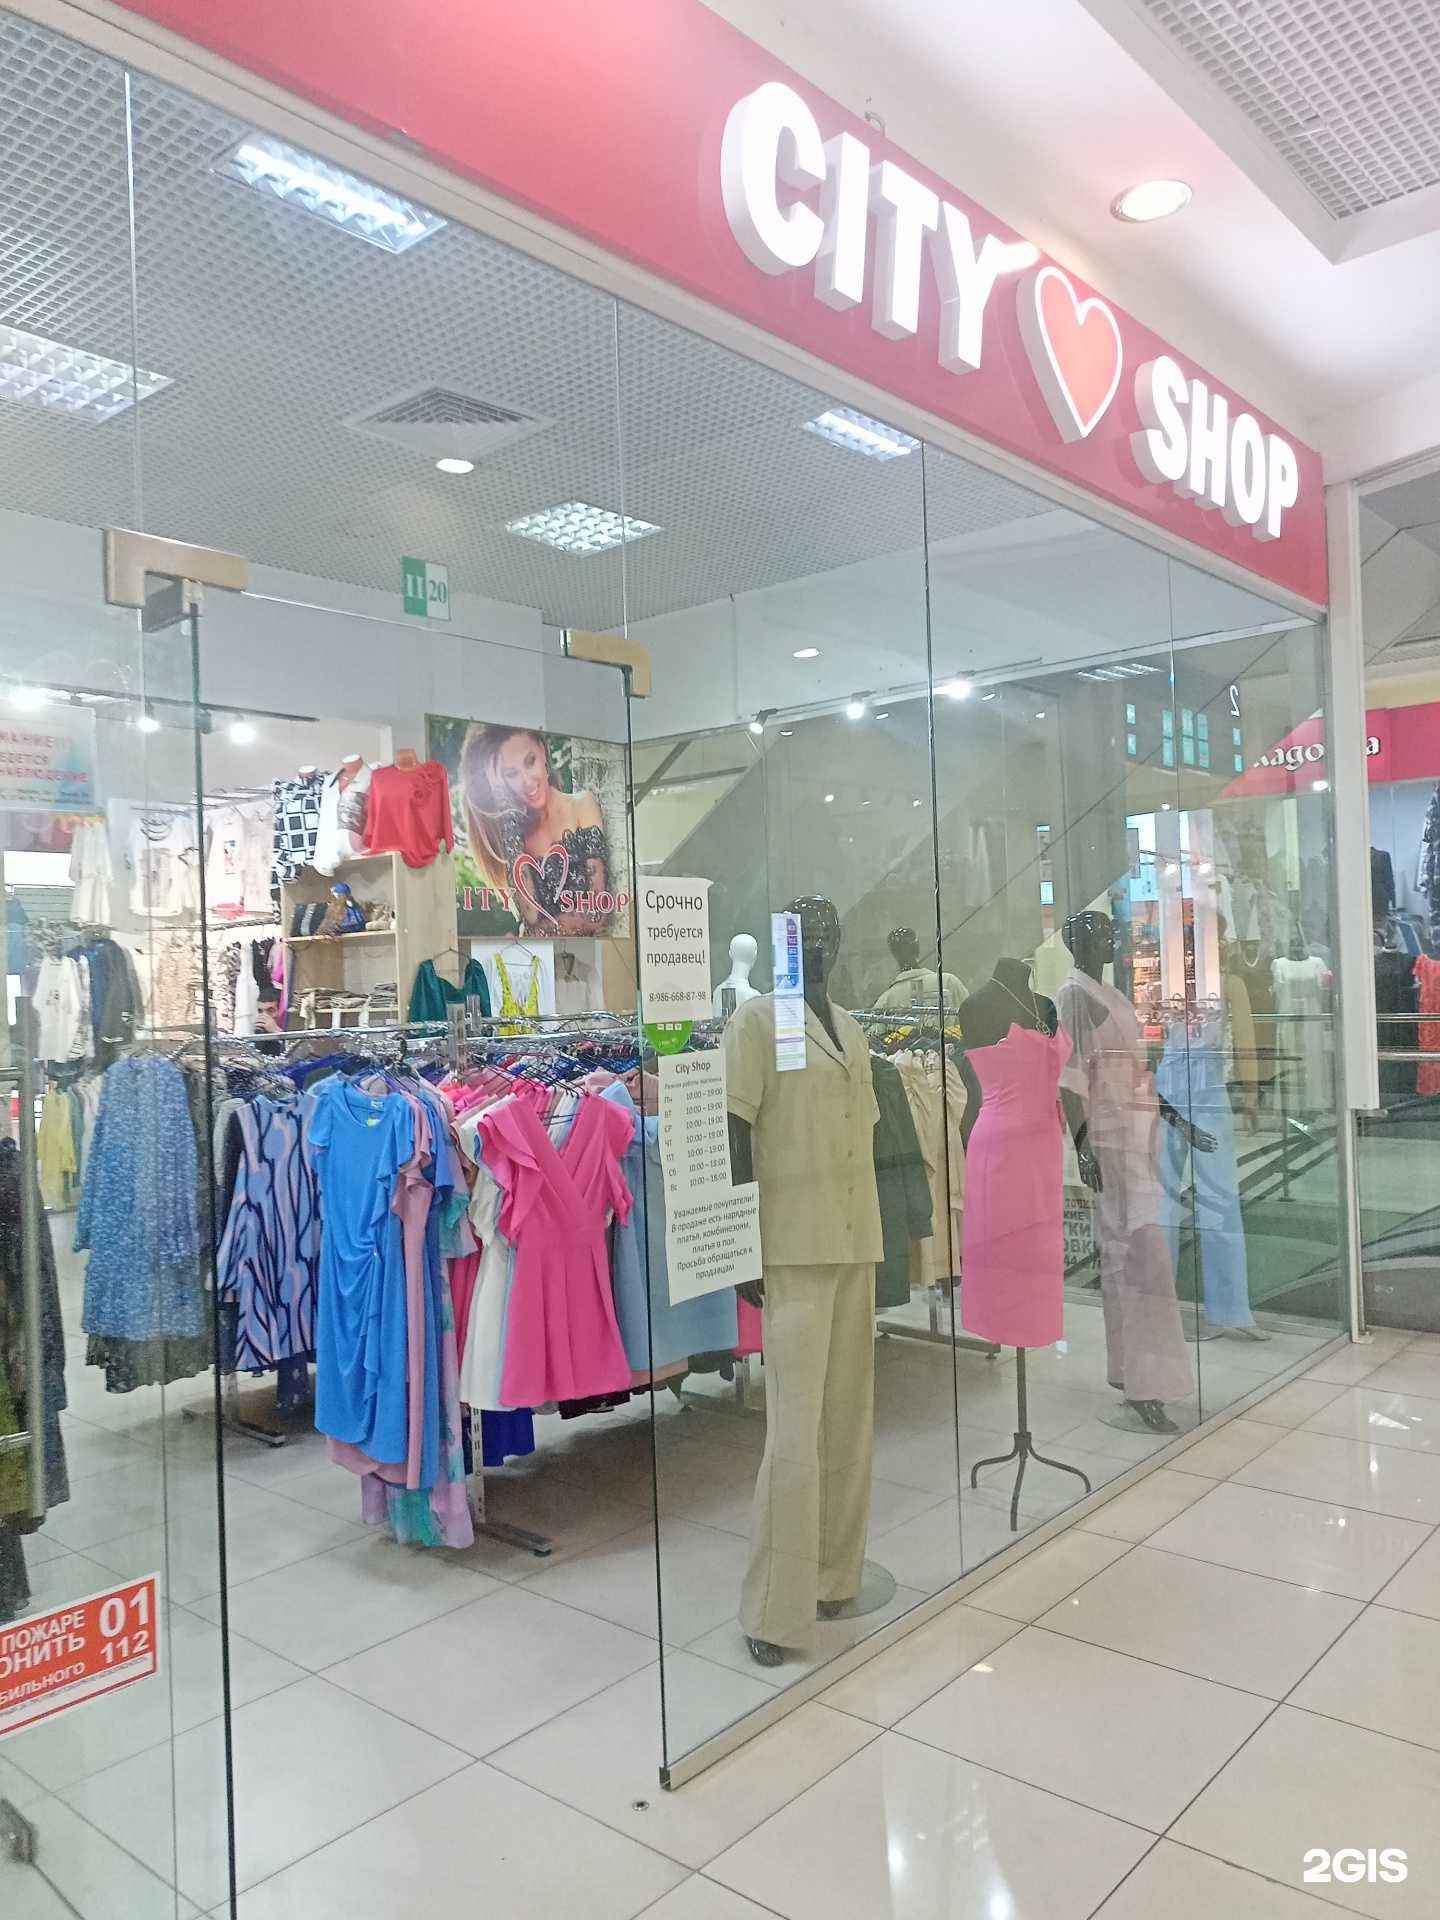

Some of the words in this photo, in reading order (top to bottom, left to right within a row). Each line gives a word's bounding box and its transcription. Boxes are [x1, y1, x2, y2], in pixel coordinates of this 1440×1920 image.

[721, 82, 1005, 375] CITY
[1131, 355, 1299, 541] SHOP
[456, 886, 517, 912] ITY
[560, 889, 629, 914] SHOP
[646, 889, 703, 914] Срочно
[648, 923, 703, 941] требуется
[647, 950, 706, 967] продавец!
[675, 1063, 690, 1075] City
[691, 1060, 711, 1073] Shop
[673, 1203, 713, 1219] Уважаемые
[713, 1193, 754, 1209] покупатели!
[677, 1218, 707, 1232] продаже
[708, 1215, 722, 1225] есть
[723, 1207, 757, 1221] нарядные
[677, 1256, 706, 1272] Просьба
[707, 1247, 748, 1264] обращаться
[692, 1242, 716, 1254] платья
[99, 1586, 149, 1638] 01
[1, 1609, 85, 1654] ПОЖАРЕ
[0, 1633, 86, 1679] ОНИТЬ
[100, 1630, 149, 1664] 112
[0, 1662, 86, 1705] БИЛЬНОГО
